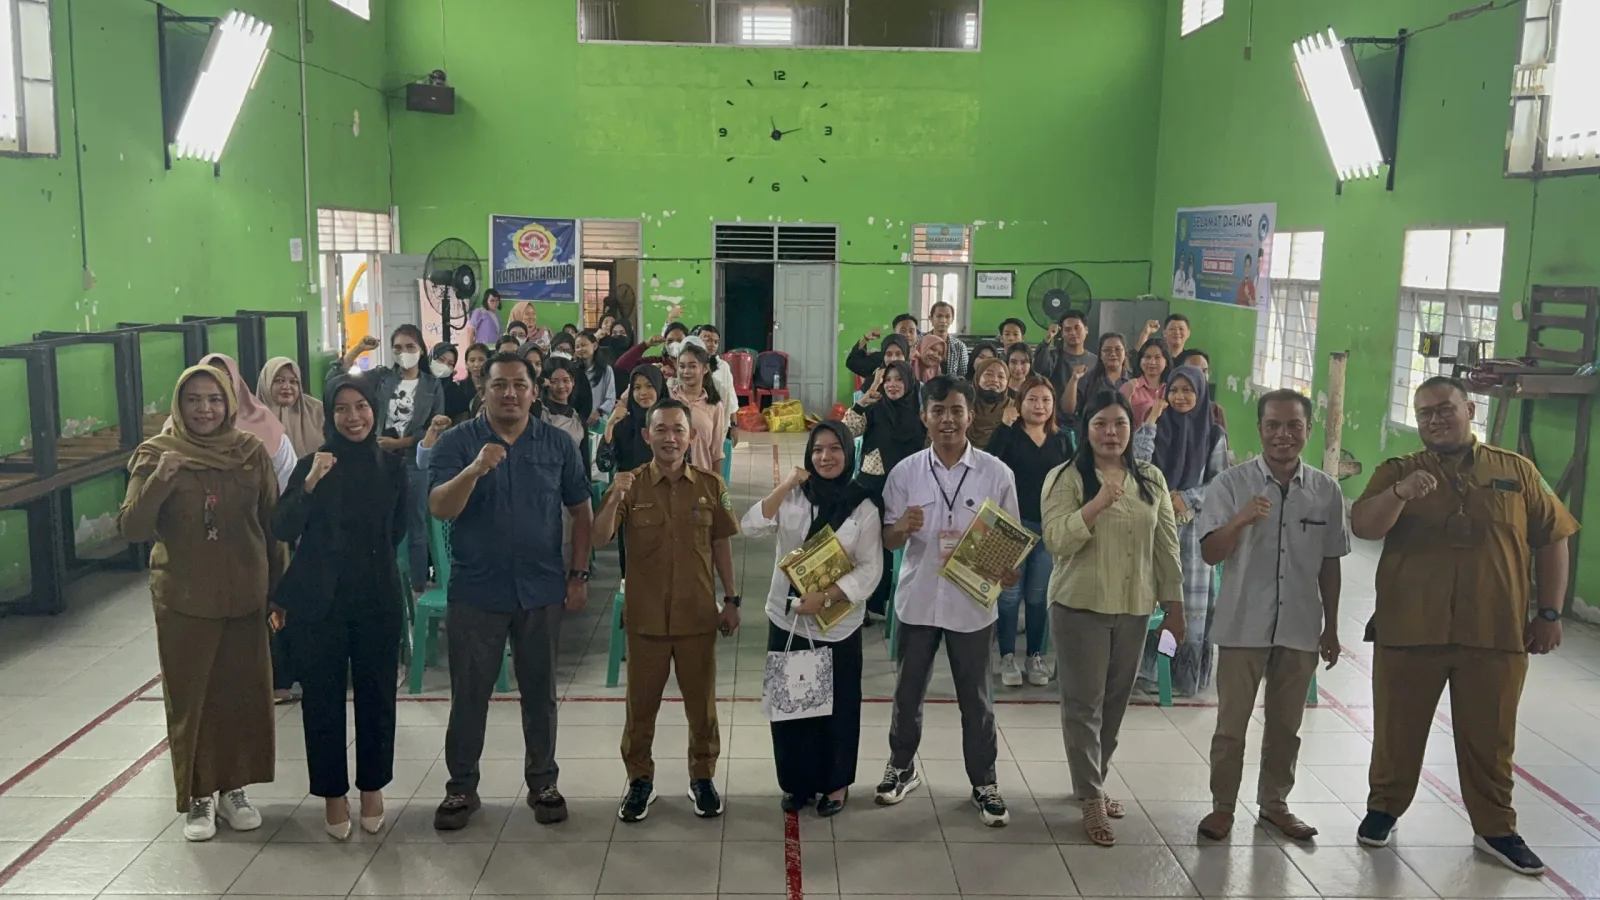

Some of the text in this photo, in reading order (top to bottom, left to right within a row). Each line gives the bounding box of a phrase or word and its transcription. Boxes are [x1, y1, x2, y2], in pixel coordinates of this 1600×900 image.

[773, 70, 786, 81] 12
[718, 127, 728, 138] 9
[824, 126, 833, 136] 3
[771, 182, 781, 192] 6
[1192, 213, 1253, 228] SELAMAT DATANG
